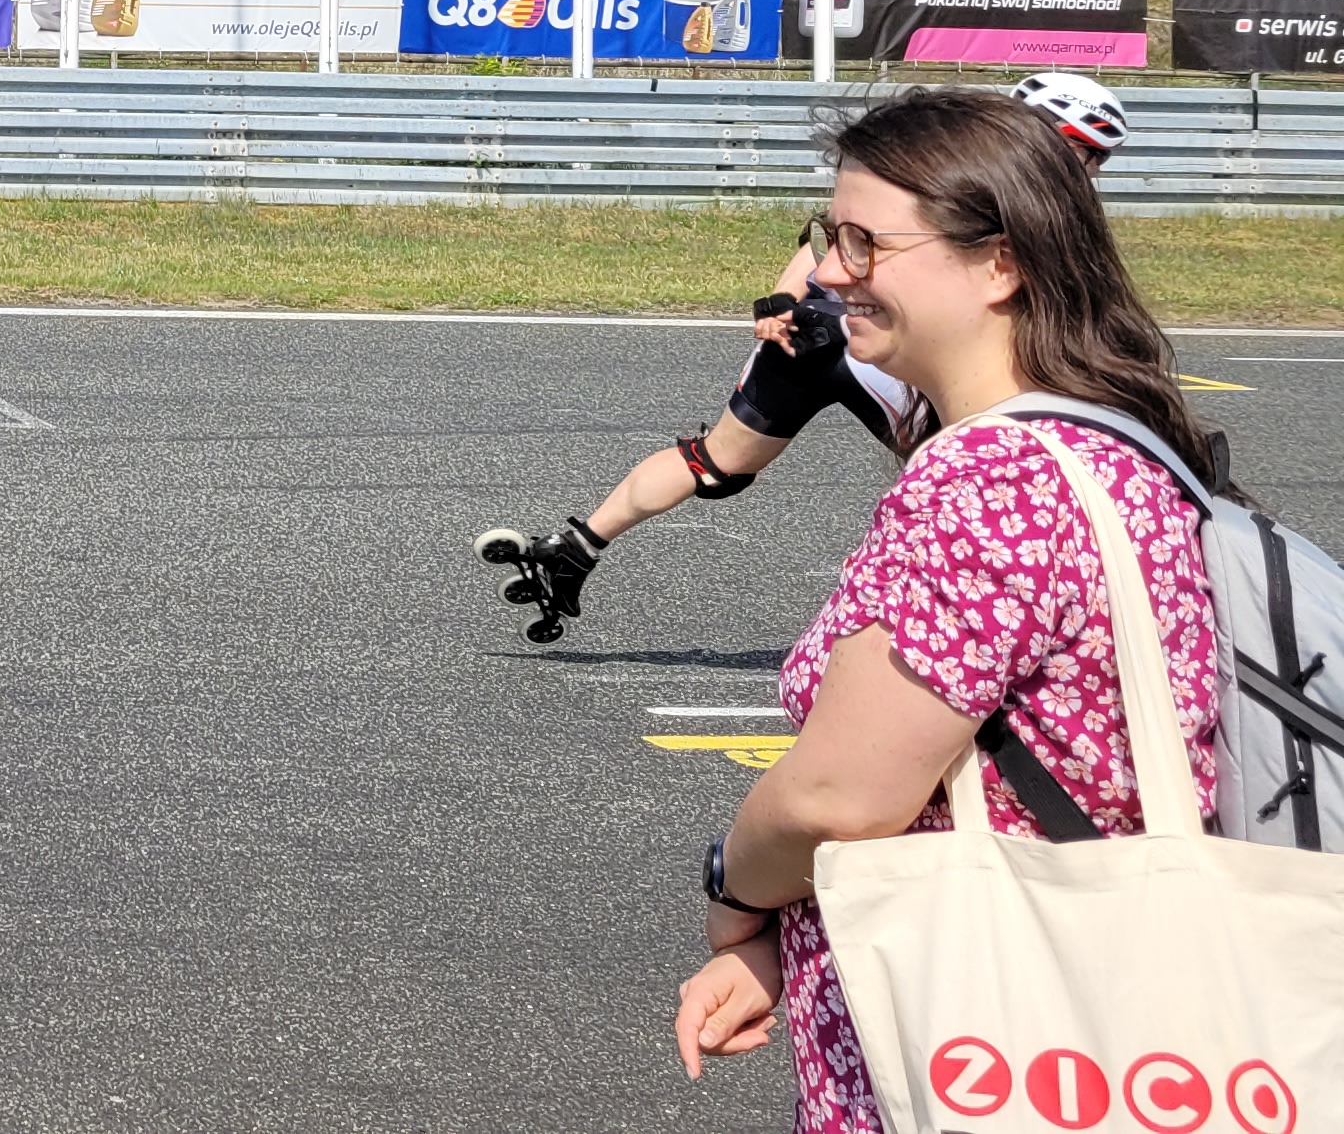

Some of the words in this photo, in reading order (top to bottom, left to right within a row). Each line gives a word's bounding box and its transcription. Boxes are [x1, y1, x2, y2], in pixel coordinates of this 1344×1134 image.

[211, 19, 379, 41] www.olejeQ8ils.pl
[1258, 14, 1338, 37] serwis
[1012, 40, 1116, 55] www.qarmax.pl
[1305, 48, 1328, 64] ul.
[929, 1035, 1298, 1134] ZICO
